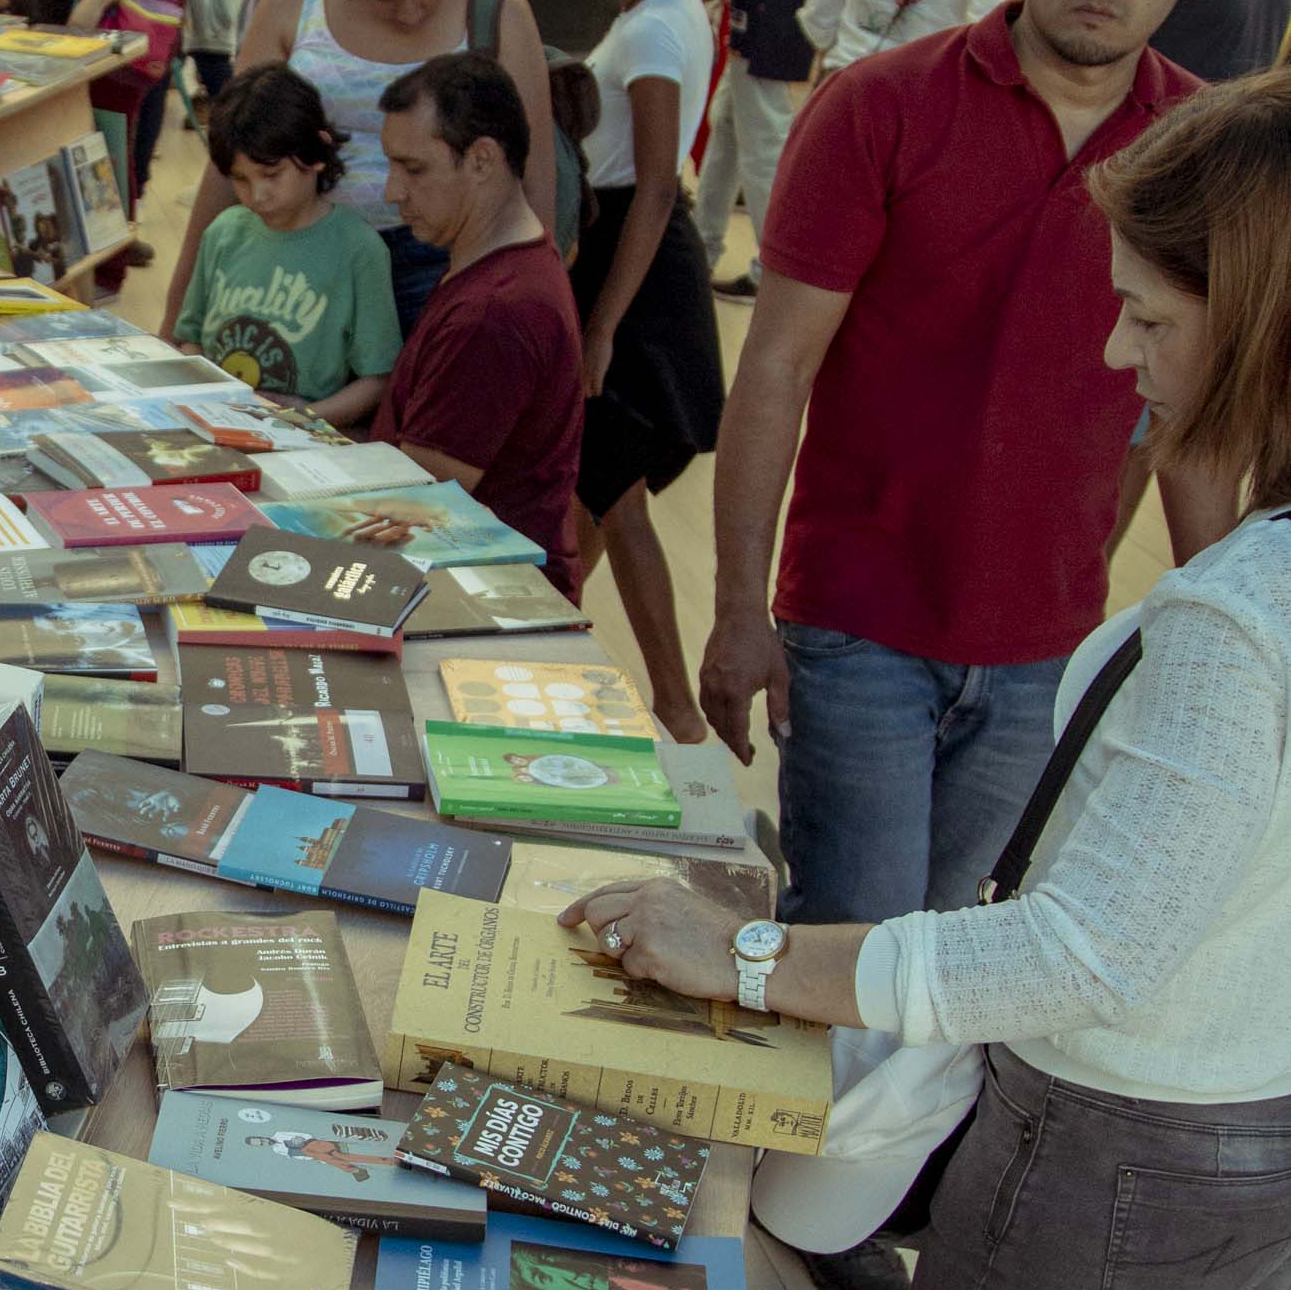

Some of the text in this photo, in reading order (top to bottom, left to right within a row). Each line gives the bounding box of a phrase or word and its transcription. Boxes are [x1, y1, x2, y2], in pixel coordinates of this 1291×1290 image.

[334, 561, 368, 600] galáctica
[8, 754, 32, 790] BRUNET
[250, 874, 287, 890] TUCHOLSKY
[321, 889, 365, 904] GRIPSHOLM
[157, 925, 321, 945] ROCKESTRA
[158, 939, 219, 952] Entrevistas
[230, 937, 276, 947] grandes
[276, 936, 296, 944] del
[297, 935, 323, 944] rock
[423, 931, 459, 990] EL ARTE
[464, 906, 500, 1034] CONSTRUCTOR DE ÓRGANOS
[7, 988, 51, 1075] BIBLIOTECA CHILENA
[473, 1097, 519, 1158] MIS DÍAS
[731, 1091, 747, 1138] VALLADOLID
[497, 1103, 544, 1168] CONTIGO
[14, 1150, 77, 1262] LA BIBLIA DEL
[46, 1158, 107, 1271] GUITARRISTA
[527, 1192, 547, 1206] PACO
[551, 1201, 602, 1224] CONTIGO
[348, 1216, 399, 1232] LA VIDA
[440, 1258, 451, 1285] polifónico
[453, 1259, 463, 1281] Argullol
